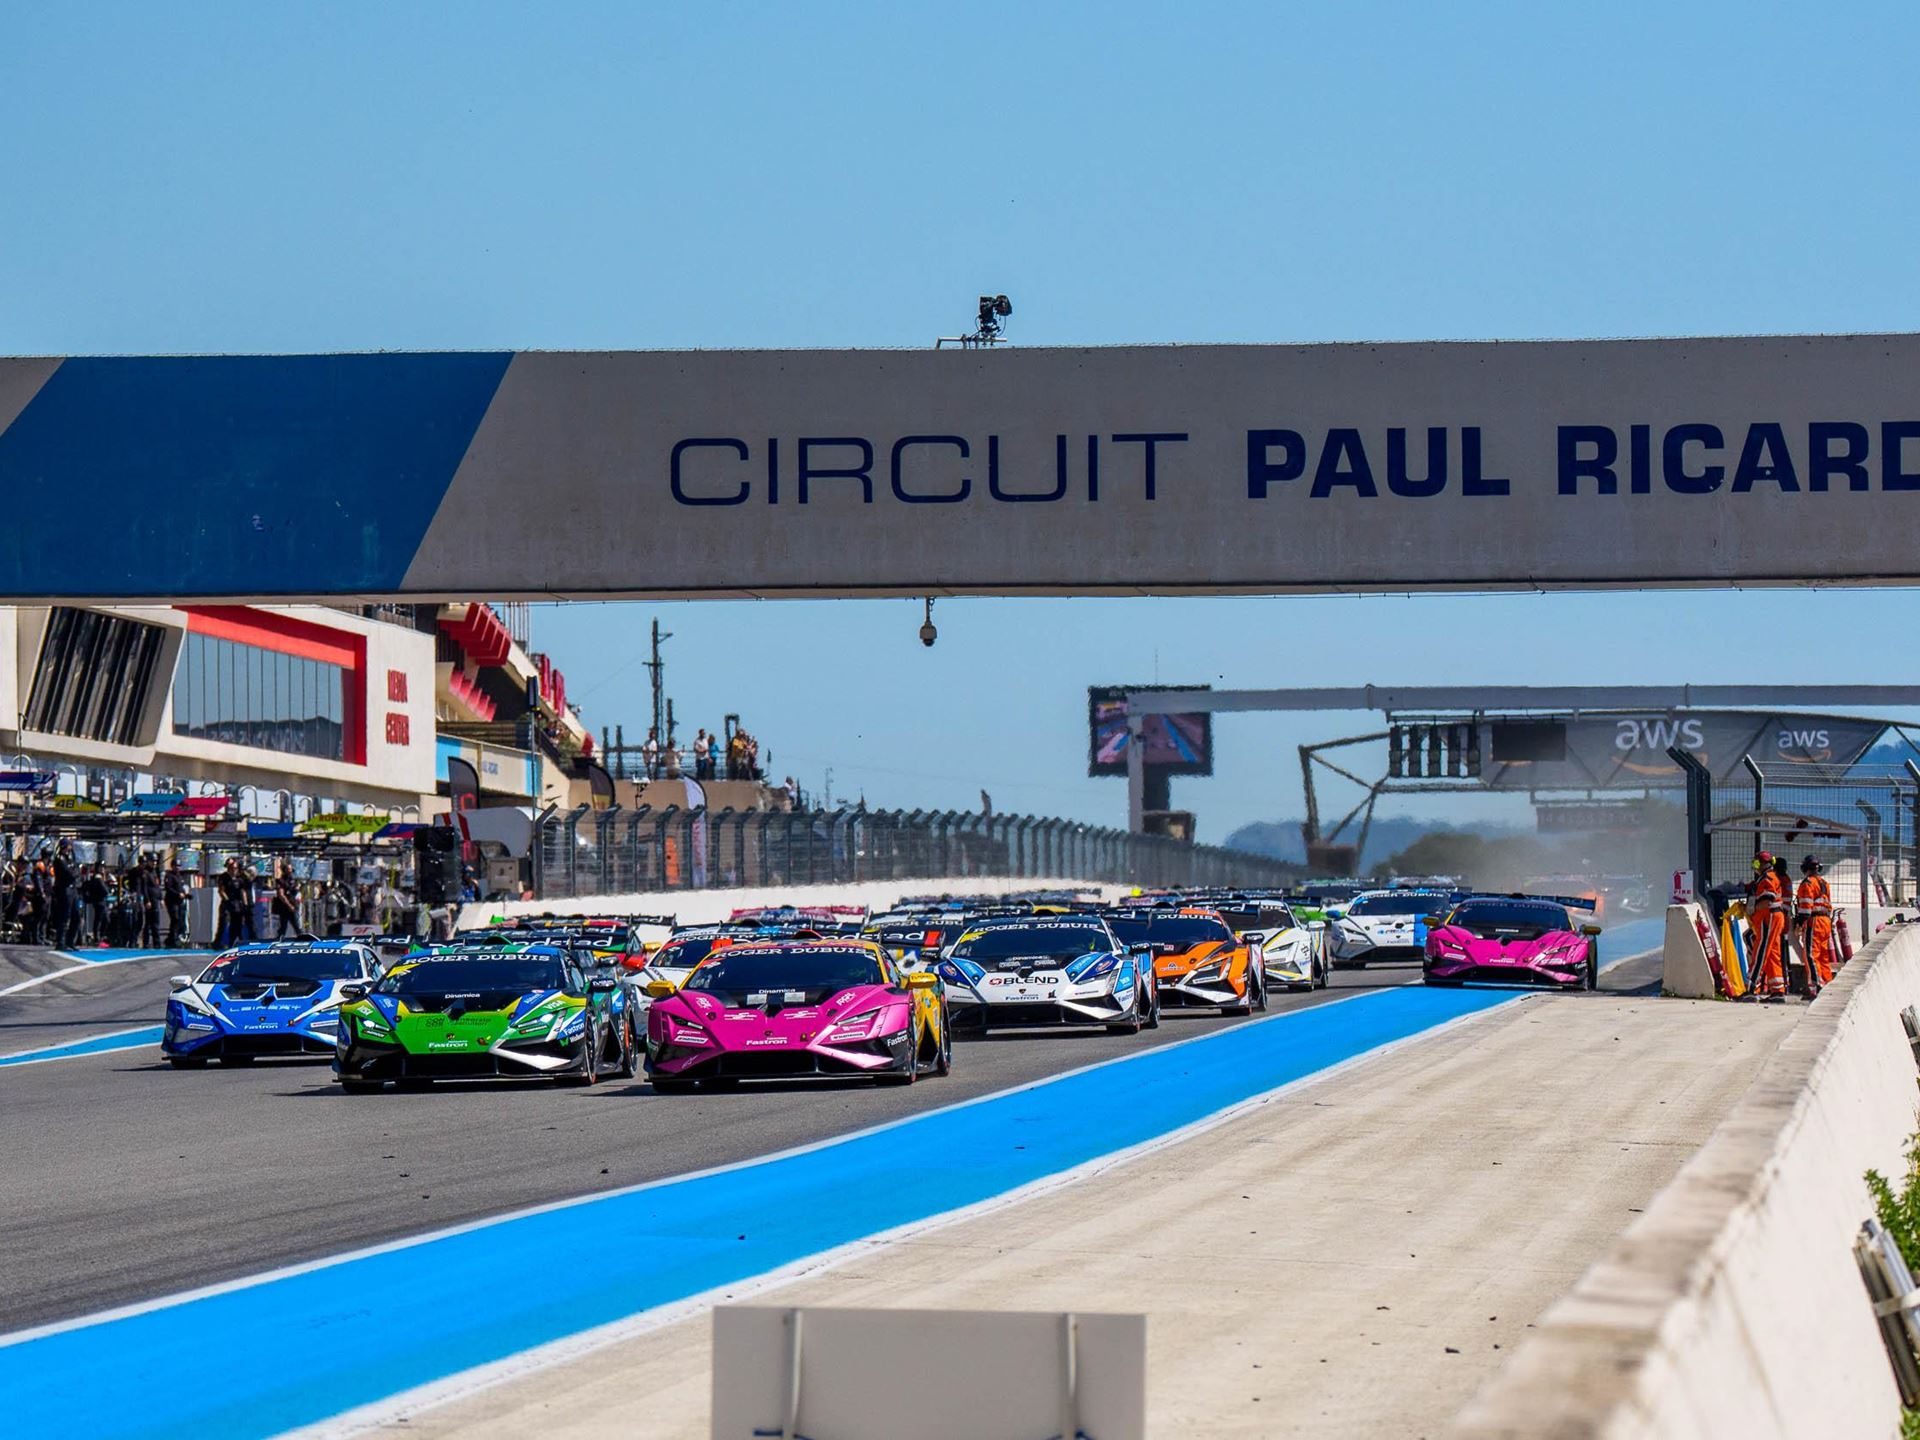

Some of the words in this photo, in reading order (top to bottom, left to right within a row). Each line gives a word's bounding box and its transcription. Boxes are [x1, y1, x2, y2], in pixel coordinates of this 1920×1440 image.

[670, 433, 1188, 505] CIRCUIT
[1247, 426, 1510, 499] PAUL
[1557, 421, 1920, 495] RICARD
[1615, 719, 1704, 750] aws
[1778, 728, 1830, 749] aws
[975, 923, 1029, 933] ROGER
[225, 949, 281, 958] ROGER
[402, 955, 470, 965] ROGER
[476, 954, 550, 962] DUBUIS
[714, 948, 782, 959] ROGER
[1003, 976, 1059, 985] BLEND
[563, 1021, 586, 1037] Fastron
[887, 1034, 909, 1048] Fastron
